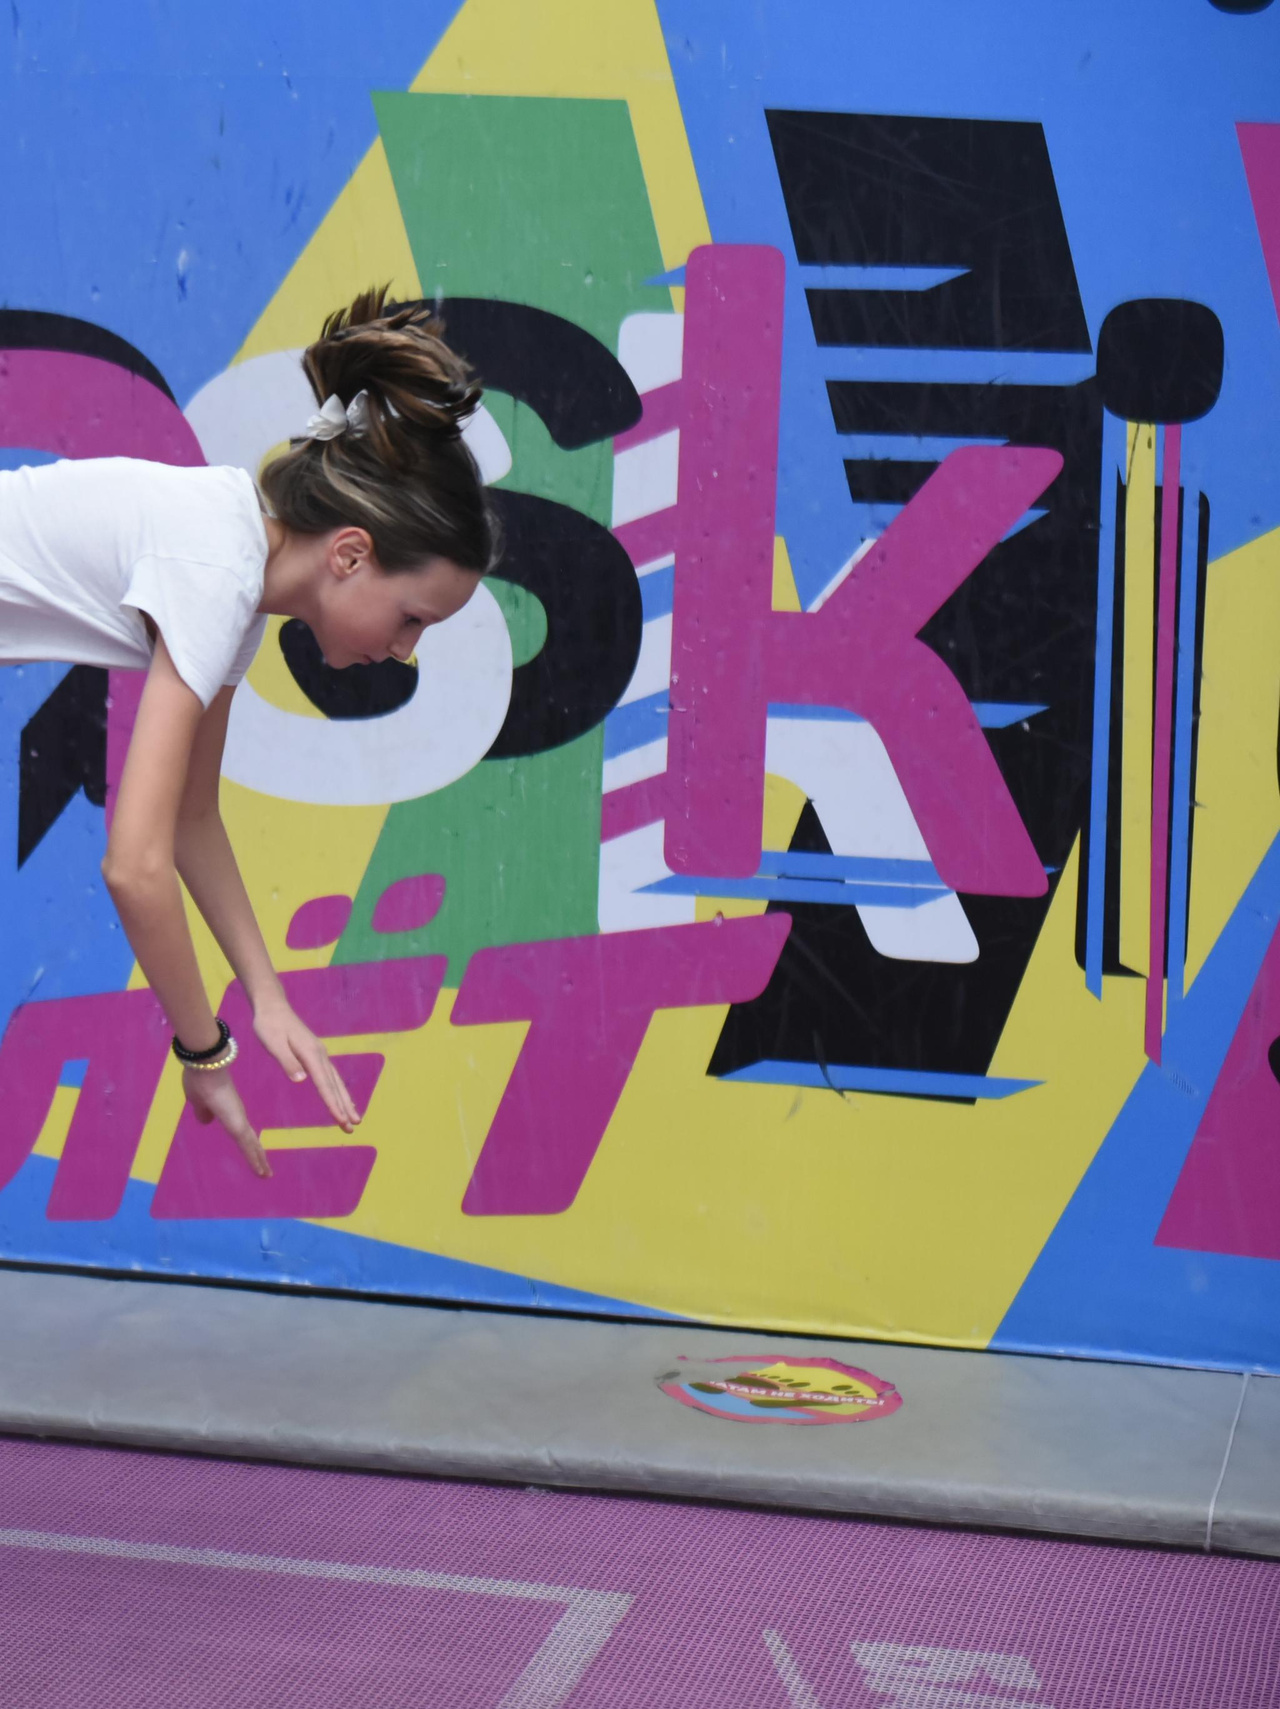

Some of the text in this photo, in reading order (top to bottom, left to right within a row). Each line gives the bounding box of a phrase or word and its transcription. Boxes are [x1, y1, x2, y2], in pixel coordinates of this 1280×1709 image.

[709, 1380, 885, 1406] АТАМ НЕ ХОДИТЬ!
